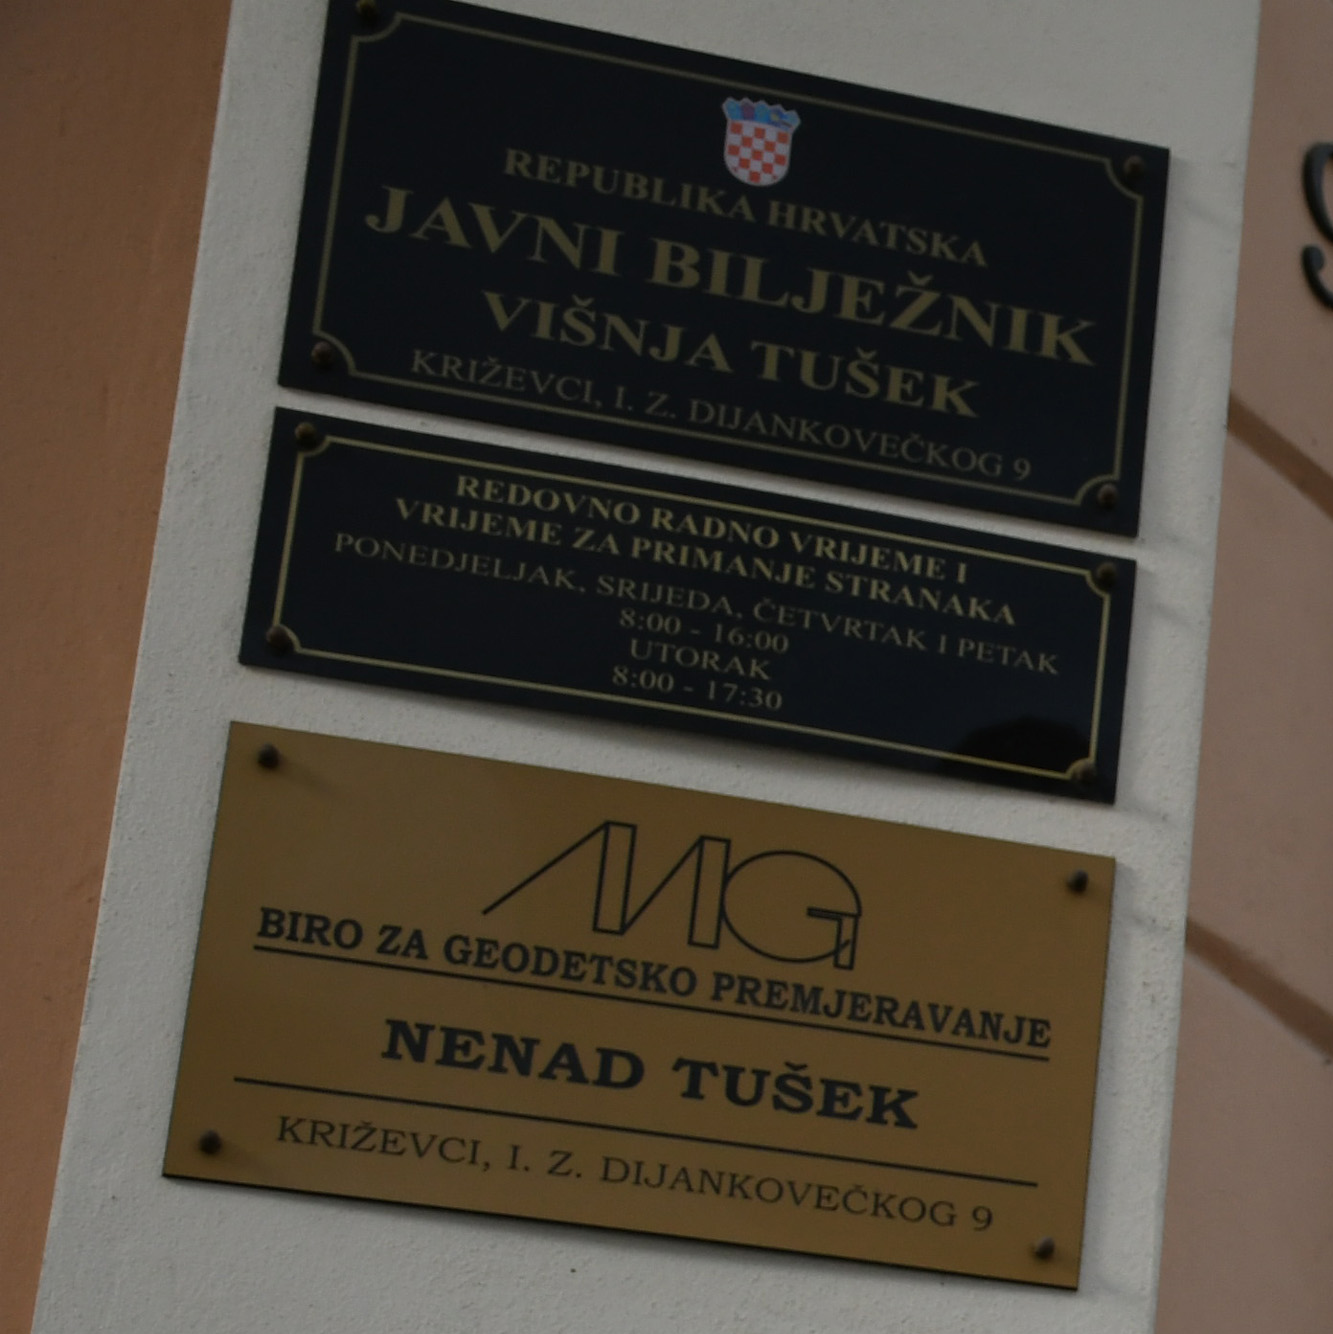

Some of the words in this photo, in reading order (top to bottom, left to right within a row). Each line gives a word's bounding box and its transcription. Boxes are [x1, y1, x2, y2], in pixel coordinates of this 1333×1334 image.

[503, 147, 756, 223] REPUBLIKA
[767, 199, 988, 268] HRVATSKA
[364, 185, 623, 277] JAVNI
[649, 237, 1094, 367] BILJEŽNIK
[483, 290, 733, 373] VIŠNJA
[749, 339, 978, 418] TUŠEK
[410, 348, 603, 410] KRIŽEVCI,
[614, 384, 634, 412] I.
[643, 390, 677, 420] Z.
[688, 398, 1004, 478] DIJANKOVEČKOG
[1012, 457, 1033, 482] 9
[395, 497, 563, 546] VRIJEME
[571, 526, 621, 556] ZA
[630, 536, 816, 589] PRIMANJE
[824, 571, 1016, 626] STRANAKA
[455, 474, 642, 525] REDOVNO
[650, 506, 780, 549] RADNO
[789, 530, 946, 581] VRIJEME
[956, 561, 968, 585] I
[334, 531, 587, 594] PONEDJELJAK,
[595, 574, 744, 620] SRIJEDA,
[752, 597, 927, 652] ČETVRTAK
[937, 633, 948, 655] I
[957, 637, 1059, 676] PETAK
[618, 608, 683, 635] 8:00
[714, 622, 790, 654] 16:00
[629, 637, 771, 682] UTORAK
[611, 664, 676, 693] 8:00
[707, 679, 784, 711] 17:30
[255, 905, 365, 952] BIRO
[374, 923, 430, 962] ZA
[442, 933, 699, 999] GEODETSKO
[711, 970, 1053, 1050] PREMJERAVANJE
[379, 1017, 646, 1091] NENAD
[670, 1056, 920, 1131] TUŠEK
[276, 1114, 492, 1173] KRIŽEVCI,
[507, 1143, 531, 1173] I.
[545, 1148, 583, 1180] Z.
[599, 1155, 958, 1228] DIJANKOVEČKOG
[970, 1204, 994, 1233] 9
